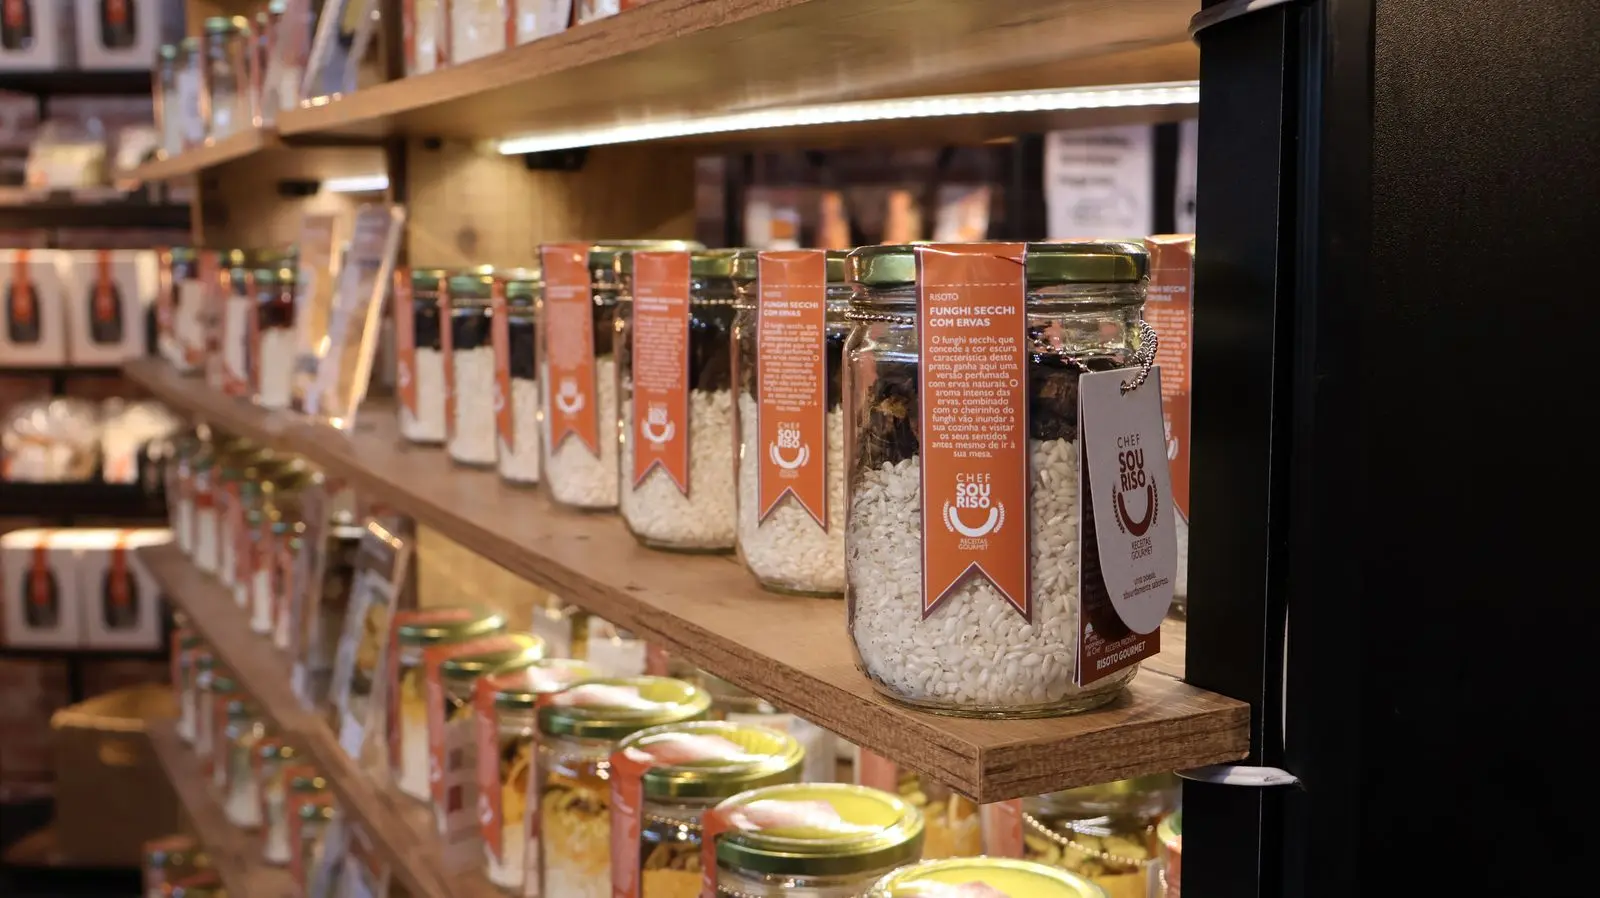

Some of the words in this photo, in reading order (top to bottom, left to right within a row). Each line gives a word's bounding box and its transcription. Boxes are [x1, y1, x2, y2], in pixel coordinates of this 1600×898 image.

[929, 292, 959, 301] RISOTO
[929, 306, 971, 315] FUNGHI
[974, 306, 1016, 315] SECCHI
[929, 318, 954, 327] COM
[957, 318, 991, 327] ERVAS
[932, 336, 940, 344] O
[942, 336, 966, 347] funghi
[969, 336, 996, 345] secchi,
[998, 337, 1014, 345] que
[929, 344, 962, 353] concede
[928, 363, 952, 372] prato,
[954, 363, 977, 373] ganha
[980, 362, 997, 372] aqui
[964, 371, 1009, 381] perfumada
[972, 380, 1008, 388] naturais.
[1009, 379, 1019, 388] O
[996, 388, 1010, 396] das
[963, 397, 1009, 405] combinado
[960, 406, 1000, 414] cheirinho
[1002, 406, 1014, 414] do
[932, 414, 956, 425] funghi
[959, 415, 973, 423] vão
[976, 415, 1007, 423] inundar
[948, 423, 979, 431] cozinha
[989, 423, 1014, 431] visitar
[778, 429, 800, 440] SOU
[972, 432, 1007, 440] sentidos
[988, 441, 999, 449] de
[1001, 441, 1008, 449] ir
[1117, 433, 1140, 448] CHEF
[1118, 448, 1144, 473] SOU
[956, 473, 991, 482] CHEF
[1120, 469, 1146, 492] RISO
[956, 483, 990, 497] SOU
[956, 496, 990, 508] RISO
[1131, 537, 1151, 550] RECEITAS
[1131, 545, 1153, 560] GOURMET
[1096, 653, 1118, 670] RISOTO
[1118, 640, 1146, 660] GOURMET
